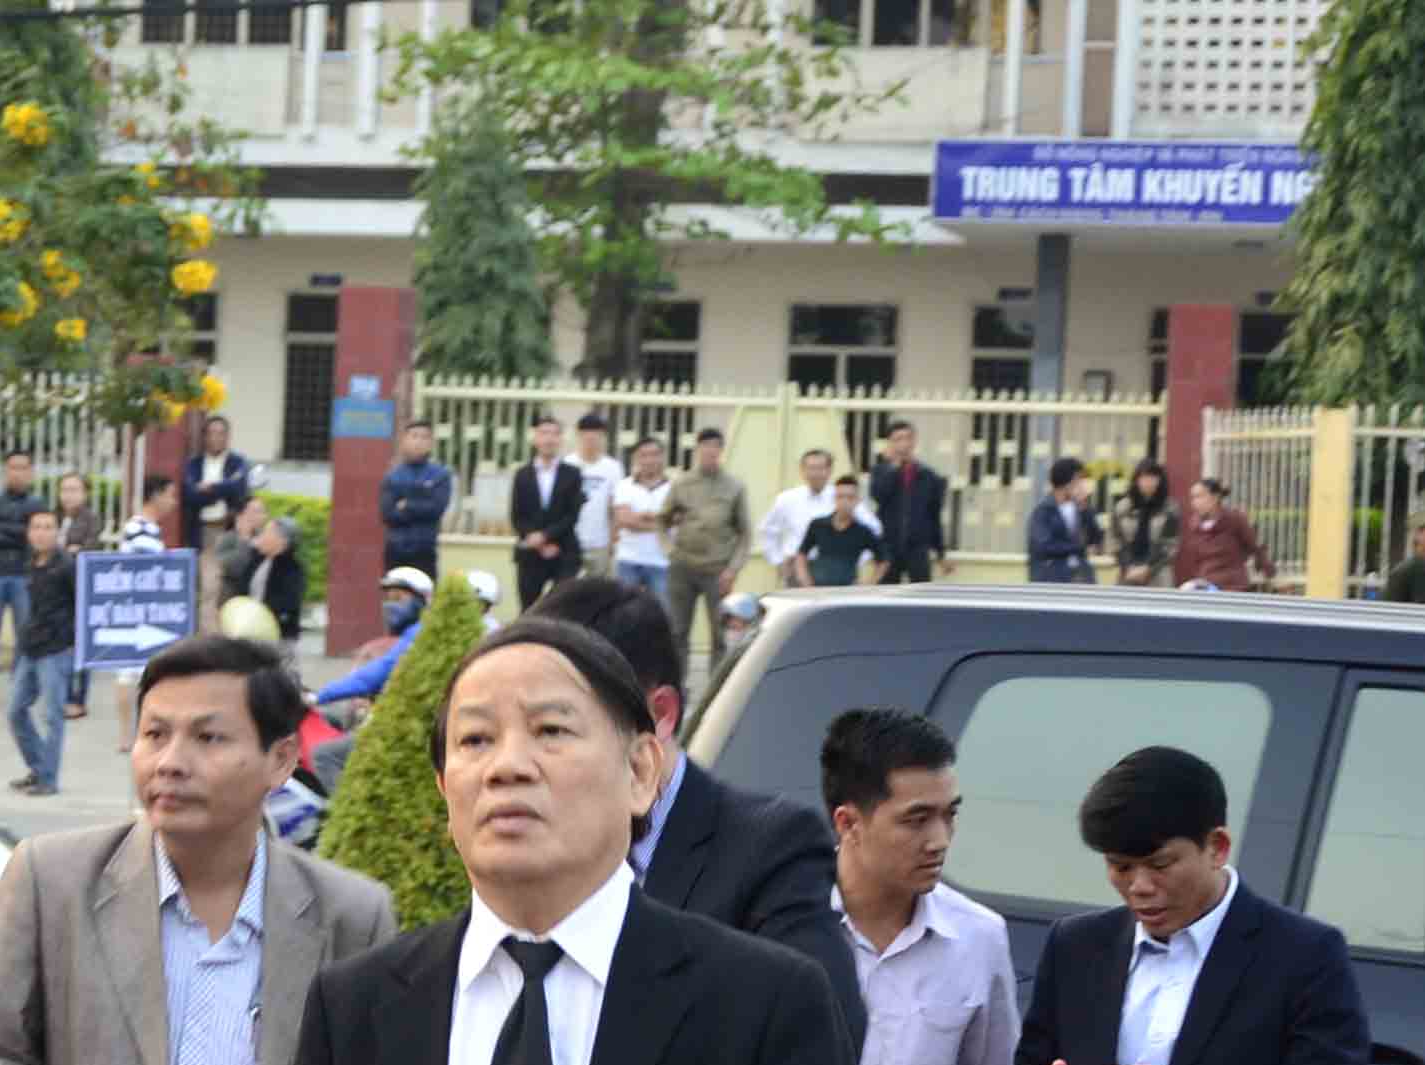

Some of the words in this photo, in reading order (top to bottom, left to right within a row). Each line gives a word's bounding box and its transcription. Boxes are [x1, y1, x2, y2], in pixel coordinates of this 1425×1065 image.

[960, 165, 1060, 201] TRUNG
[1068, 162, 1135, 203] TÂM
[1142, 161, 1262, 205] KHUYẾN
